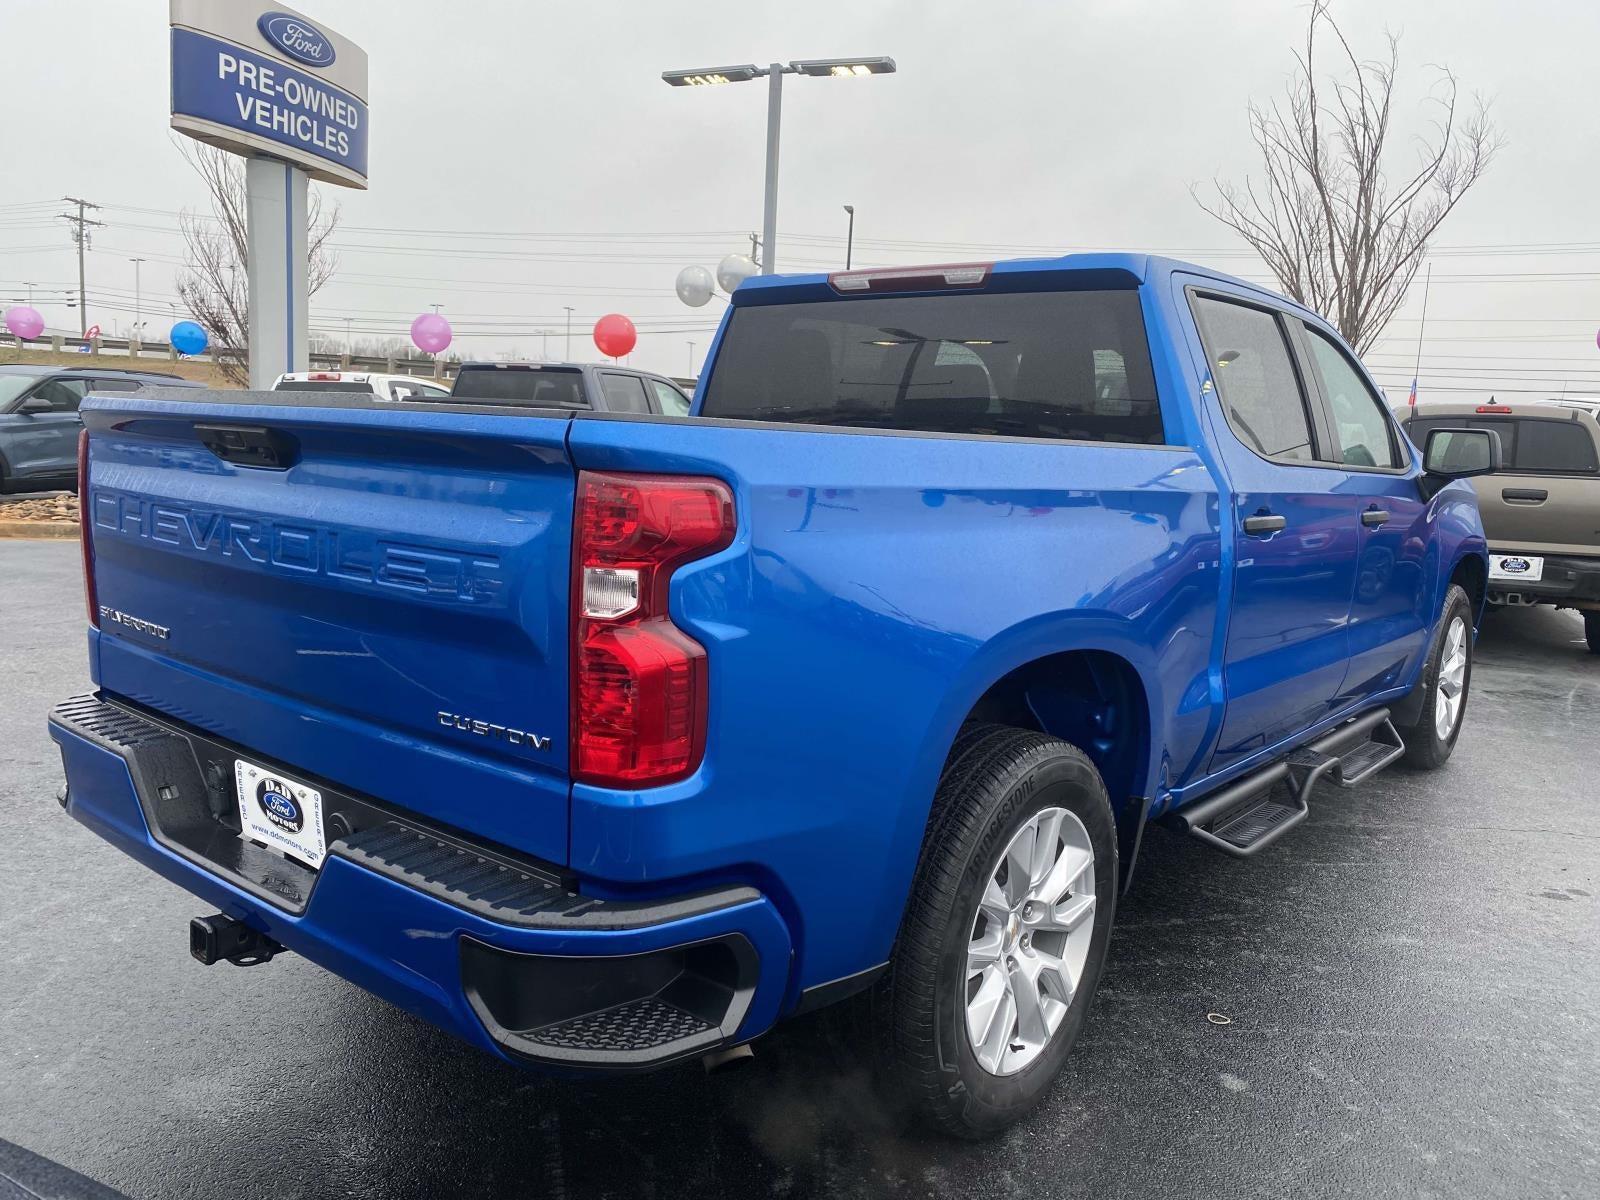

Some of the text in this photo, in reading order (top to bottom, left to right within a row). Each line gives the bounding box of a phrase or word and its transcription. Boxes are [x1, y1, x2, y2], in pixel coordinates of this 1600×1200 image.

[282, 23, 323, 58] Ford
[218, 52, 358, 130] PRE-OWNED
[235, 92, 349, 157] VEHICLES
[94, 491, 501, 600] CHEVROLET
[100, 605, 170, 640] SILVERADO
[438, 711, 551, 752] CUSTOM
[265, 780, 291, 800] D&D
[271, 795, 291, 816] Ford
[266, 808, 299, 832] MOTORS
[251, 823, 319, 860] www.ddmotors.com
